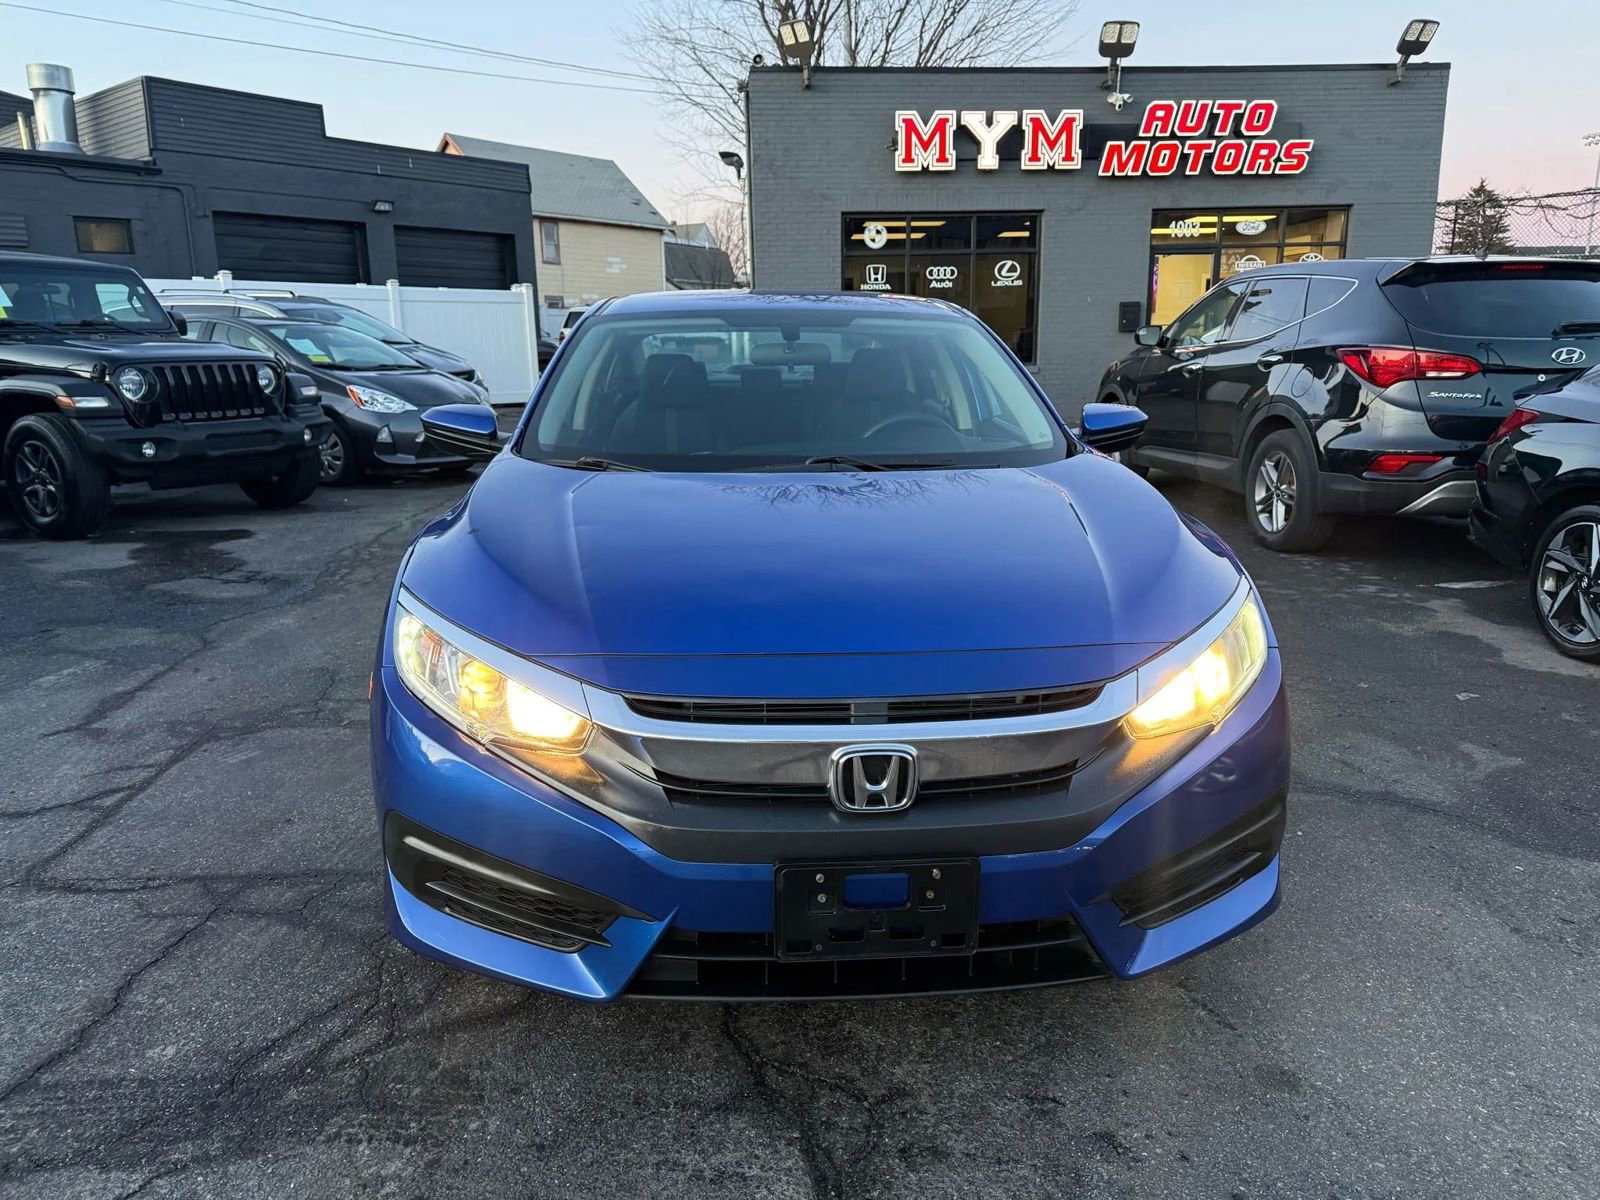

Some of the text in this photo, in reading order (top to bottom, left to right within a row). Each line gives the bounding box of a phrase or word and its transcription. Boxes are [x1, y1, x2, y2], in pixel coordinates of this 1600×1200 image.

[1138, 100, 1279, 137] AUTO
[894, 109, 1084, 171] MYM
[1098, 139, 1315, 176] MOTORS
[929, 280, 953, 288] Audi
